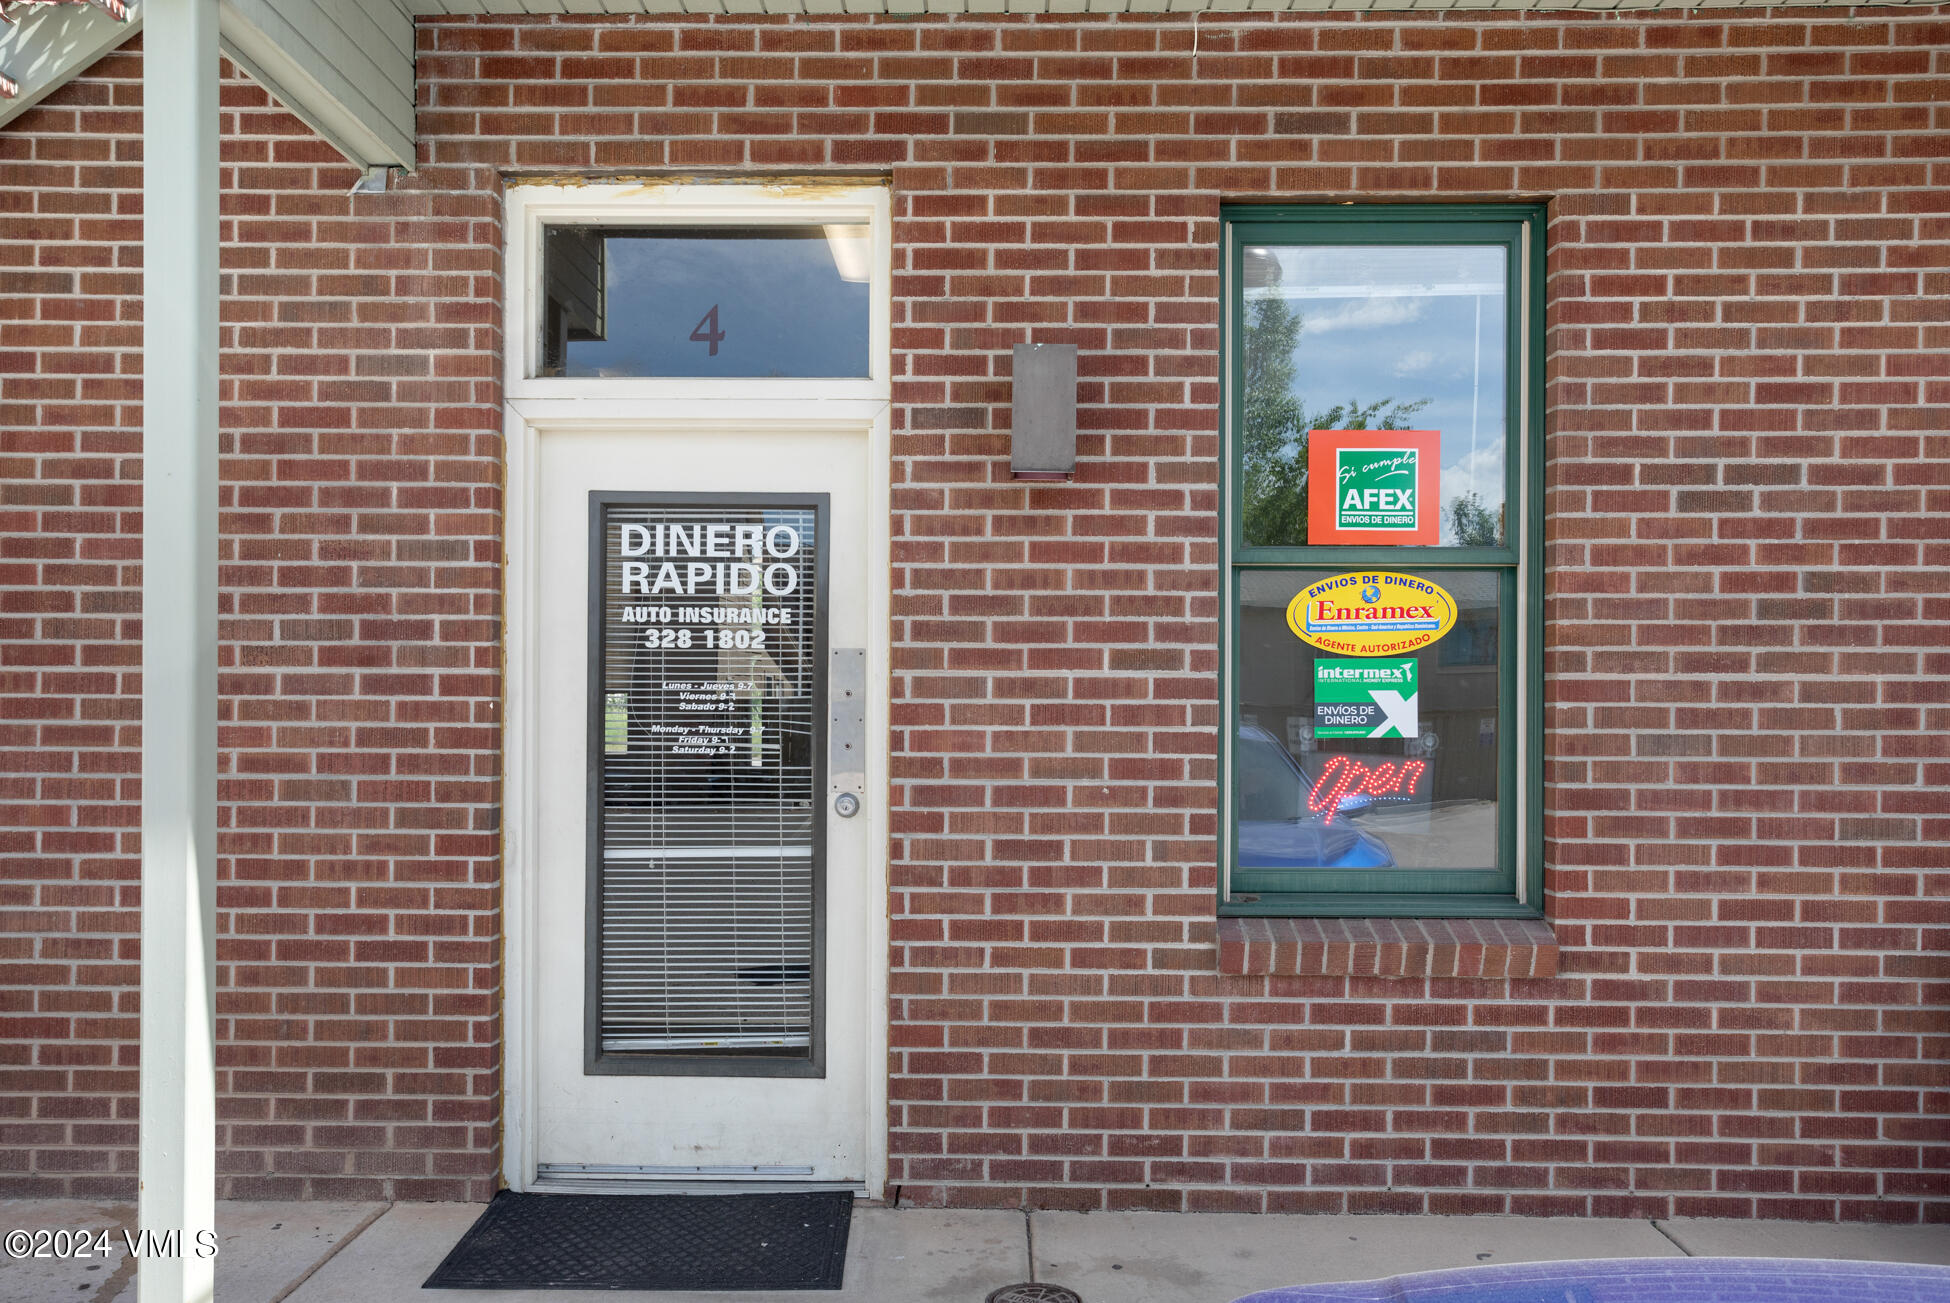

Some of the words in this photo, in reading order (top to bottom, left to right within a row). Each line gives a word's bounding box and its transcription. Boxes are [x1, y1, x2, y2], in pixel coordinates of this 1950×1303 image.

[689, 304, 726, 357] 4
[1338, 466, 1357, 485] Si
[1362, 450, 1416, 471] cumple
[1342, 488, 1413, 510] AFEX
[1341, 516, 1370, 524] ENVIOS
[1371, 516, 1382, 524] DE
[1384, 516, 1414, 524] DINERO
[620, 524, 800, 558] DINERO
[622, 562, 798, 595] RAPIDO
[1307, 576, 1357, 598] ENVIOS
[1362, 575, 1379, 584] DE
[1384, 576, 1434, 595] DINERO
[622, 606, 672, 623] AUTO
[678, 607, 792, 624] INSURANCE
[1316, 600, 1435, 621] Enramex
[644, 629, 692, 649] 328
[703, 629, 766, 649] 1802
[1314, 636, 1356, 652] AGENTE
[1360, 633, 1431, 653] AUTORIZADO
[1317, 666, 1404, 679] intermex
[662, 681, 692, 689] Lunes
[700, 681, 735, 690] Jueves
[737, 682, 753, 690] 9-7
[679, 692, 718, 700] Viernes
[679, 702, 716, 710] Sabado
[718, 703, 735, 711] 9-2
[1317, 704, 1357, 715] ENVÍOS
[1360, 706, 1375, 715] DE
[1325, 716, 1368, 724] DINERO
[651, 725, 690, 735] Monday
[698, 726, 744, 735] Thursday
[678, 736, 709, 745] Friday
[672, 746, 719, 755] Saturday
[1308, 756, 1425, 826] Open
